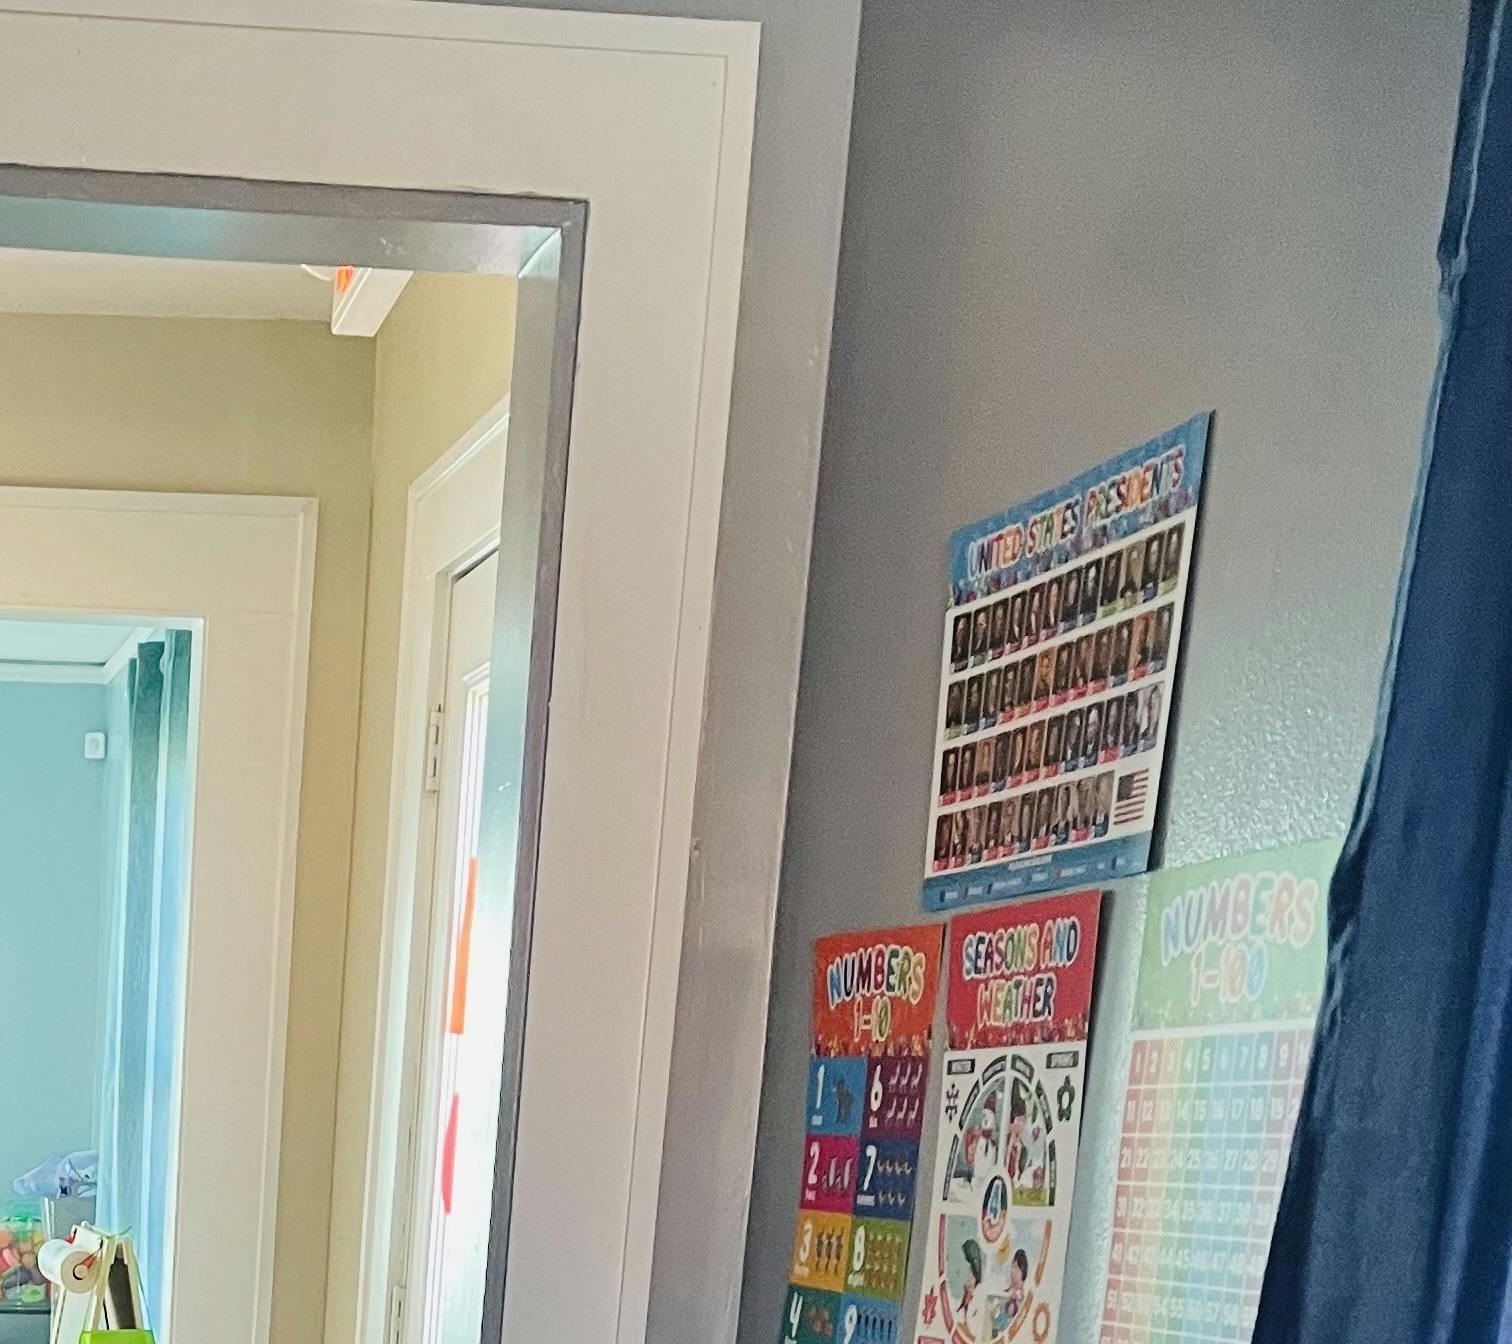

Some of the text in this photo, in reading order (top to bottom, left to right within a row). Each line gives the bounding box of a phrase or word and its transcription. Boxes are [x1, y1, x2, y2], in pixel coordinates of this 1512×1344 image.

[968, 444, 1186, 581] UNITED STATES PRESIDENTS
[962, 915, 1080, 980] SEASONS AND
[1160, 871, 1319, 967] NUMBERS
[827, 944, 925, 1010] NUMBERS
[977, 971, 1056, 1028] WEATHER
[1190, 938, 1267, 1006] 1-100
[854, 995, 891, 1043] 1-10
[815, 1063, 884, 1112] 1 6
[808, 1141, 877, 1192] 2 7
[800, 1219, 866, 1272] 3 8
[789, 1291, 803, 1338] 4
